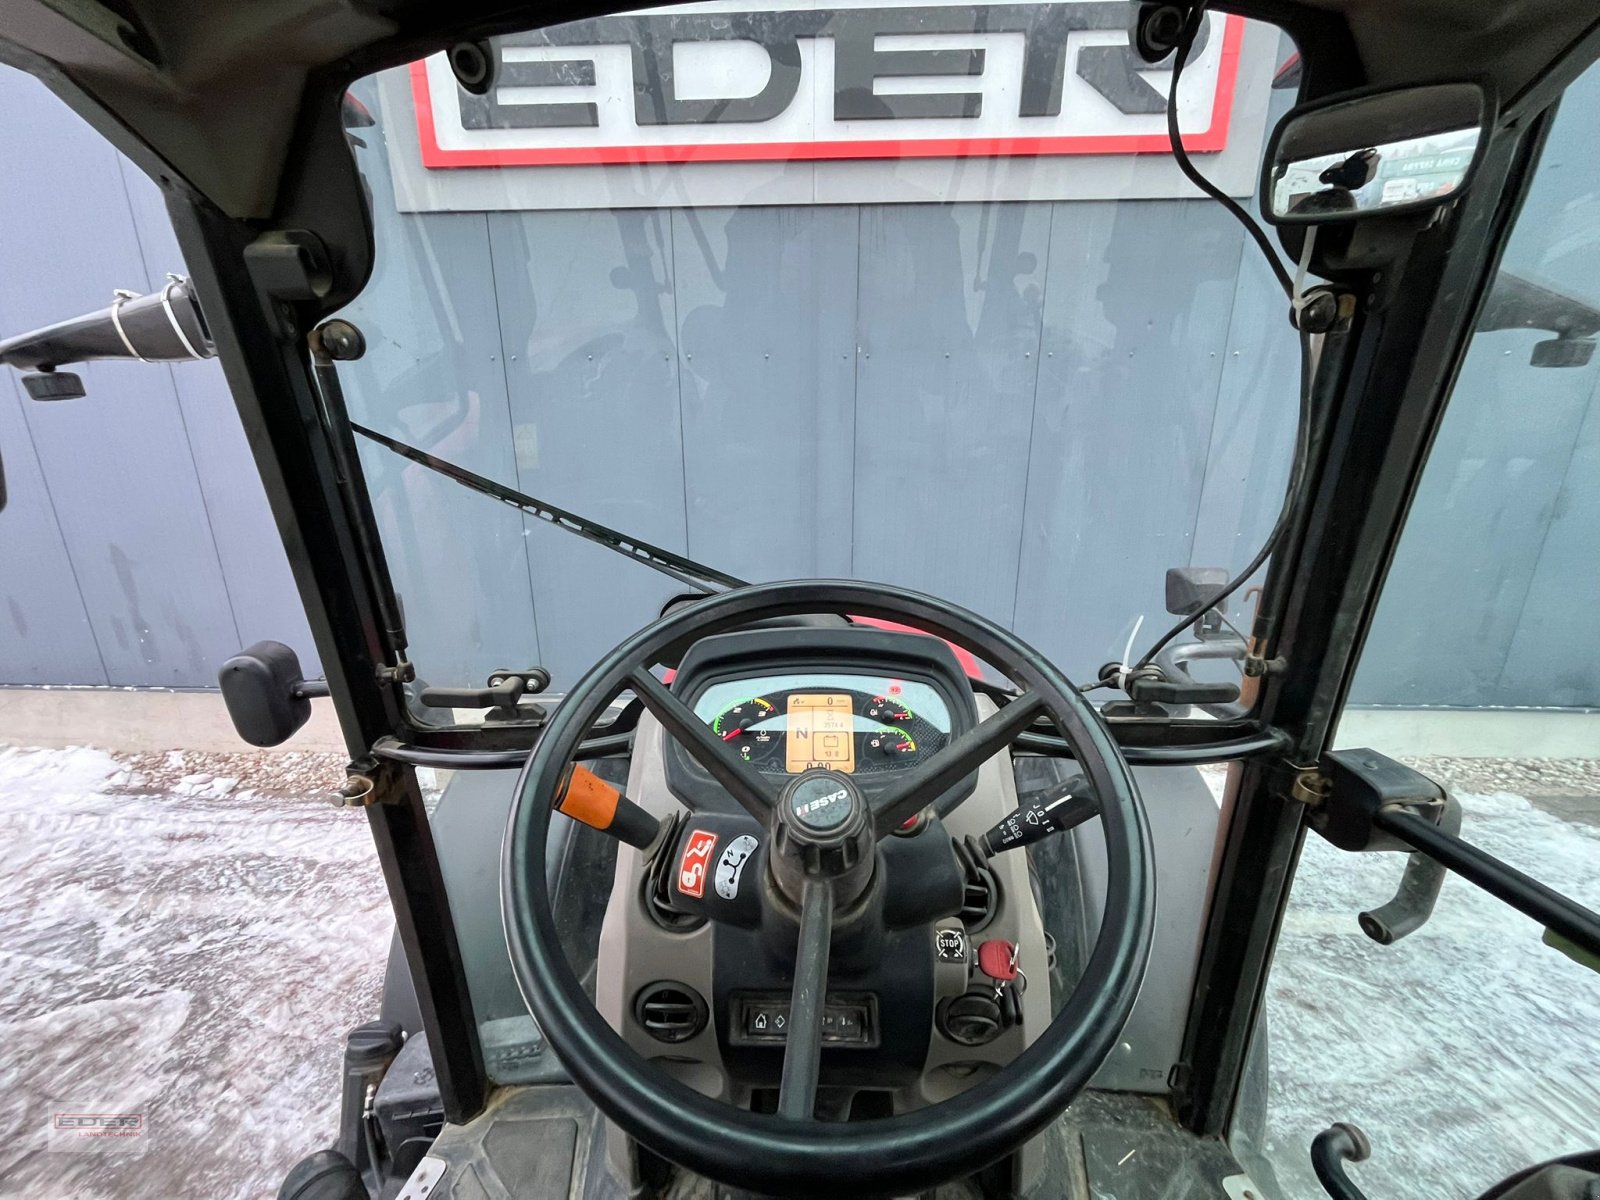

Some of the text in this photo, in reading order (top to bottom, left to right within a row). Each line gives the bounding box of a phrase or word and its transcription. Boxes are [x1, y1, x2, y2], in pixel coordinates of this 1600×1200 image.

[458, 1, 1211, 130] EDER
[796, 727, 808, 739] N
[809, 790, 848, 811] CASE
[940, 939, 959, 948] STOP
